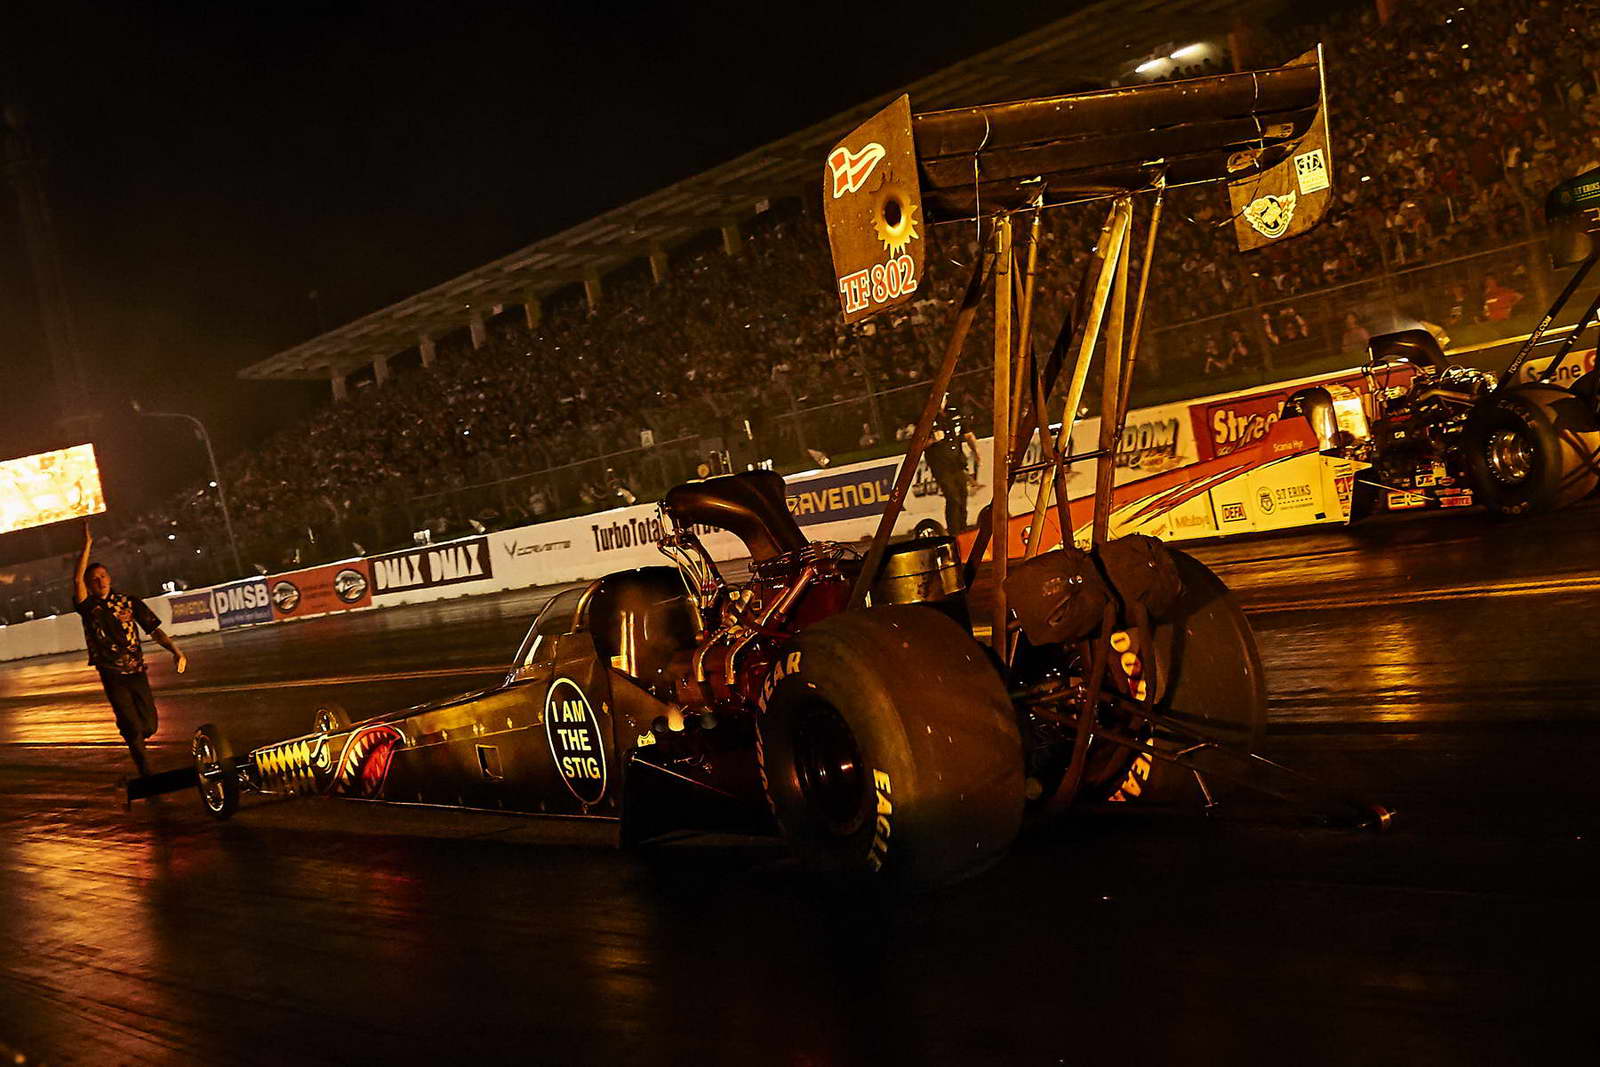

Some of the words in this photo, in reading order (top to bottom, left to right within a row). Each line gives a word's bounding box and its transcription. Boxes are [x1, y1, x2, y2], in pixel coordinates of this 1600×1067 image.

[839, 269, 871, 313] TF
[871, 254, 918, 304] 802
[374, 554, 425, 591] DMAX
[428, 543, 484, 583] DMAX
[215, 583, 270, 616] DMSB
[552, 701, 559, 722] I
[562, 700, 586, 722] AM
[557, 729, 592, 751] THE
[562, 756, 601, 779] STIG
